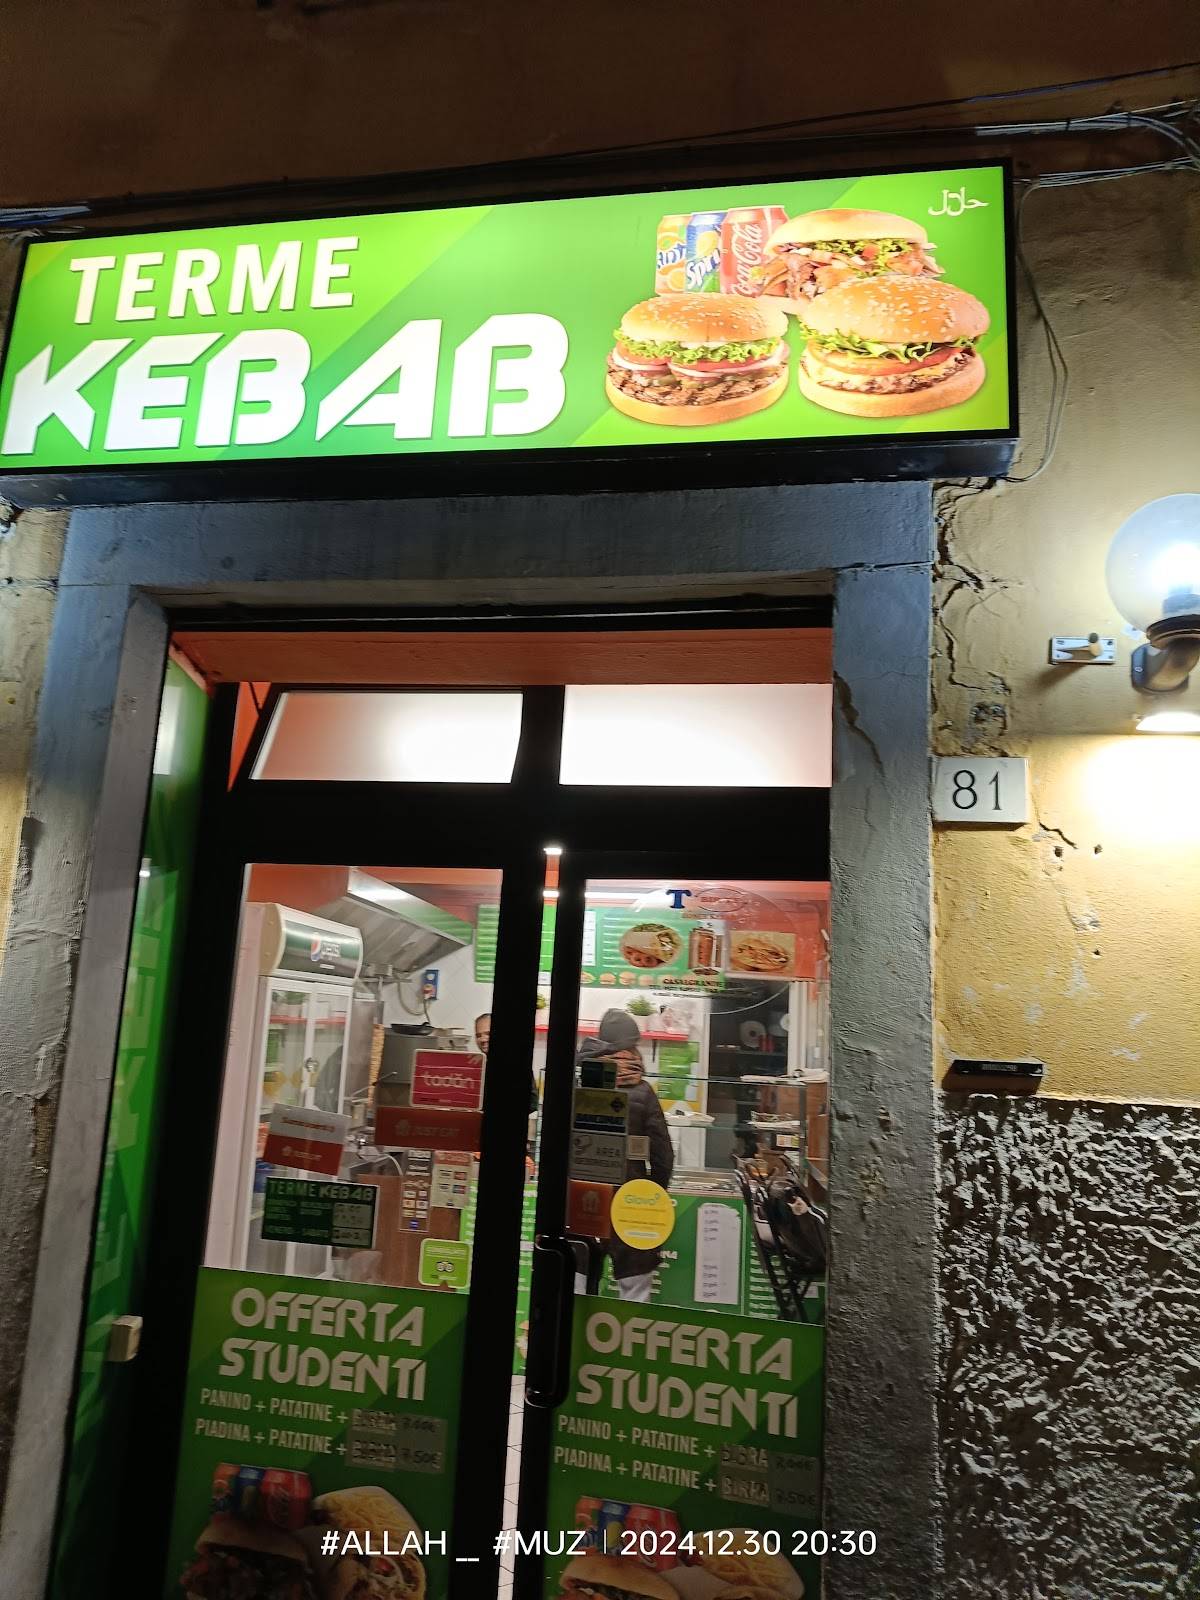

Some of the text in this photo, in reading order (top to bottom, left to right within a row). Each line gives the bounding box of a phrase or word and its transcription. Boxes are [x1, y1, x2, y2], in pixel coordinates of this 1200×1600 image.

[927, 186, 989, 217] حلال
[69, 236, 360, 325] TERME
[1, 312, 570, 456] KEBAB
[952, 769, 1003, 810] 81
[269, 1179, 375, 1201] TERME KEBAB
[231, 1287, 425, 1347] OFFERTA
[586, 1312, 794, 1381] OFFERTA
[218, 1337, 427, 1401] STUDENTI
[200, 1388, 251, 1411] PANINO
[270, 1397, 333, 1423] PATATINE
[576, 1363, 798, 1439] STUDENTI
[195, 1418, 250, 1443] PIADINA
[269, 1429, 332, 1454] PATATINE
[558, 1414, 611, 1440] PANINO
[632, 1429, 699, 1457] PATATINE
[554, 1446, 612, 1474] PIADINA
[632, 1462, 700, 1490] PATATINE
